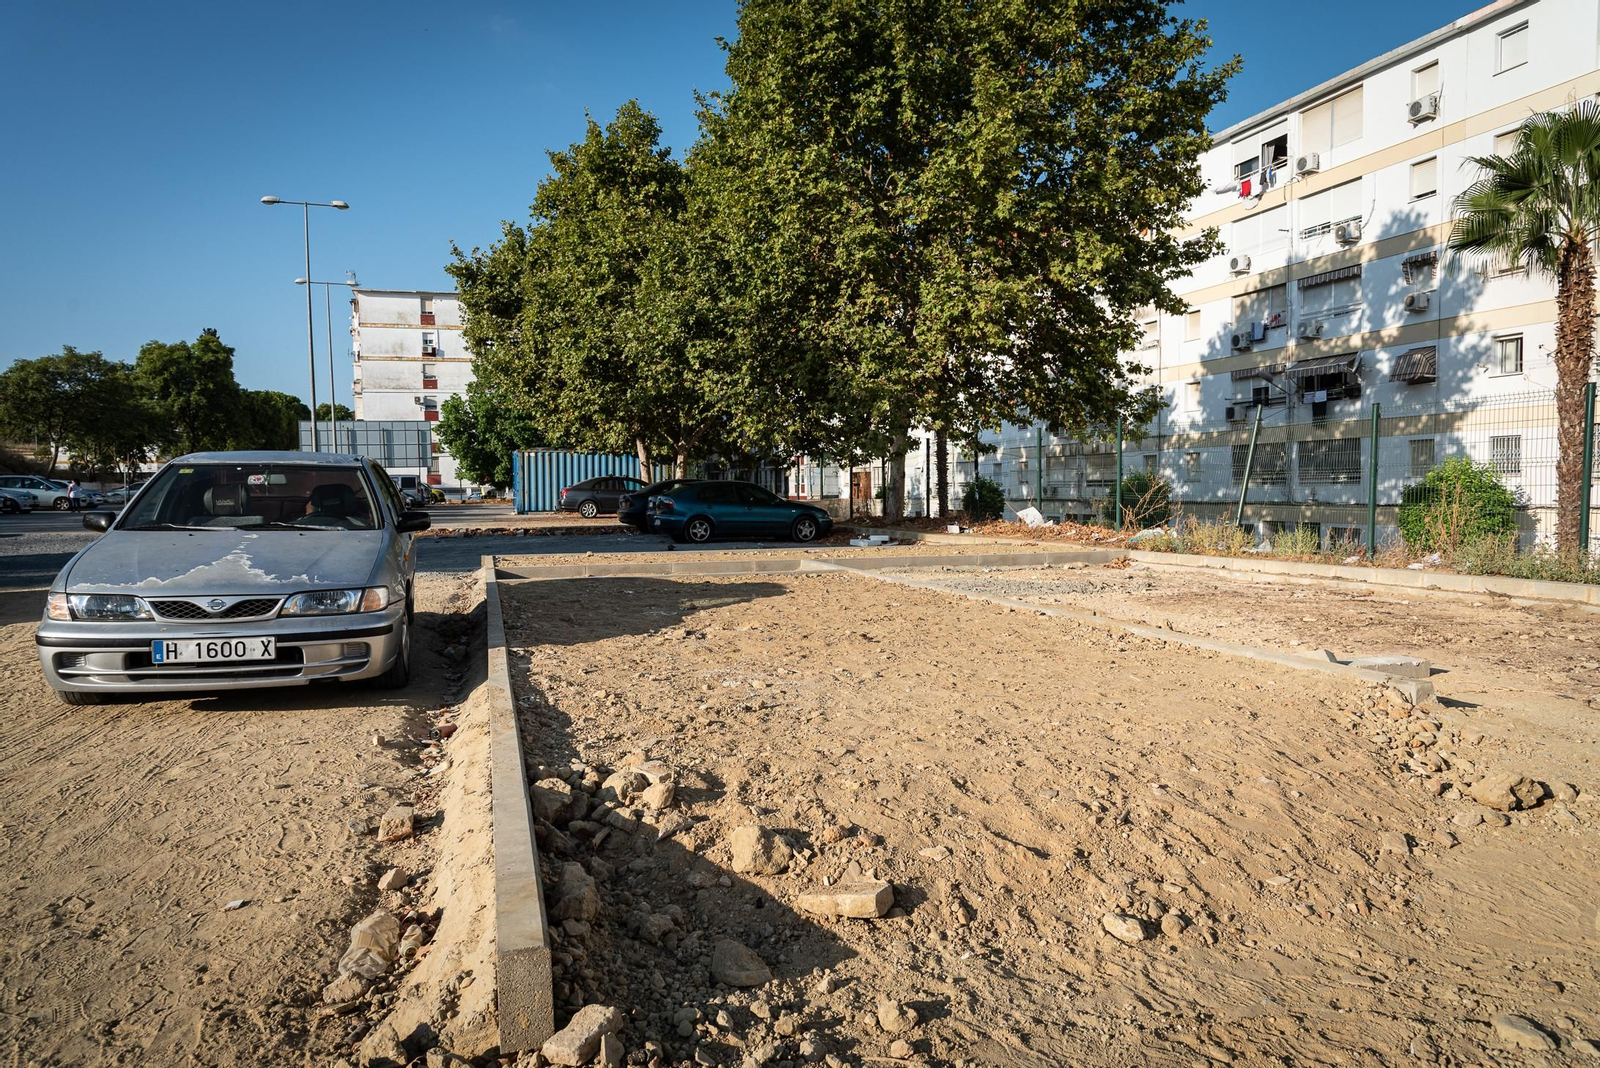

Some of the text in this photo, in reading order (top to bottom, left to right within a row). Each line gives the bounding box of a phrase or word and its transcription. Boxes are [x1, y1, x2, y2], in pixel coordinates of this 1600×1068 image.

[166, 640, 272, 660] H 1600 X
